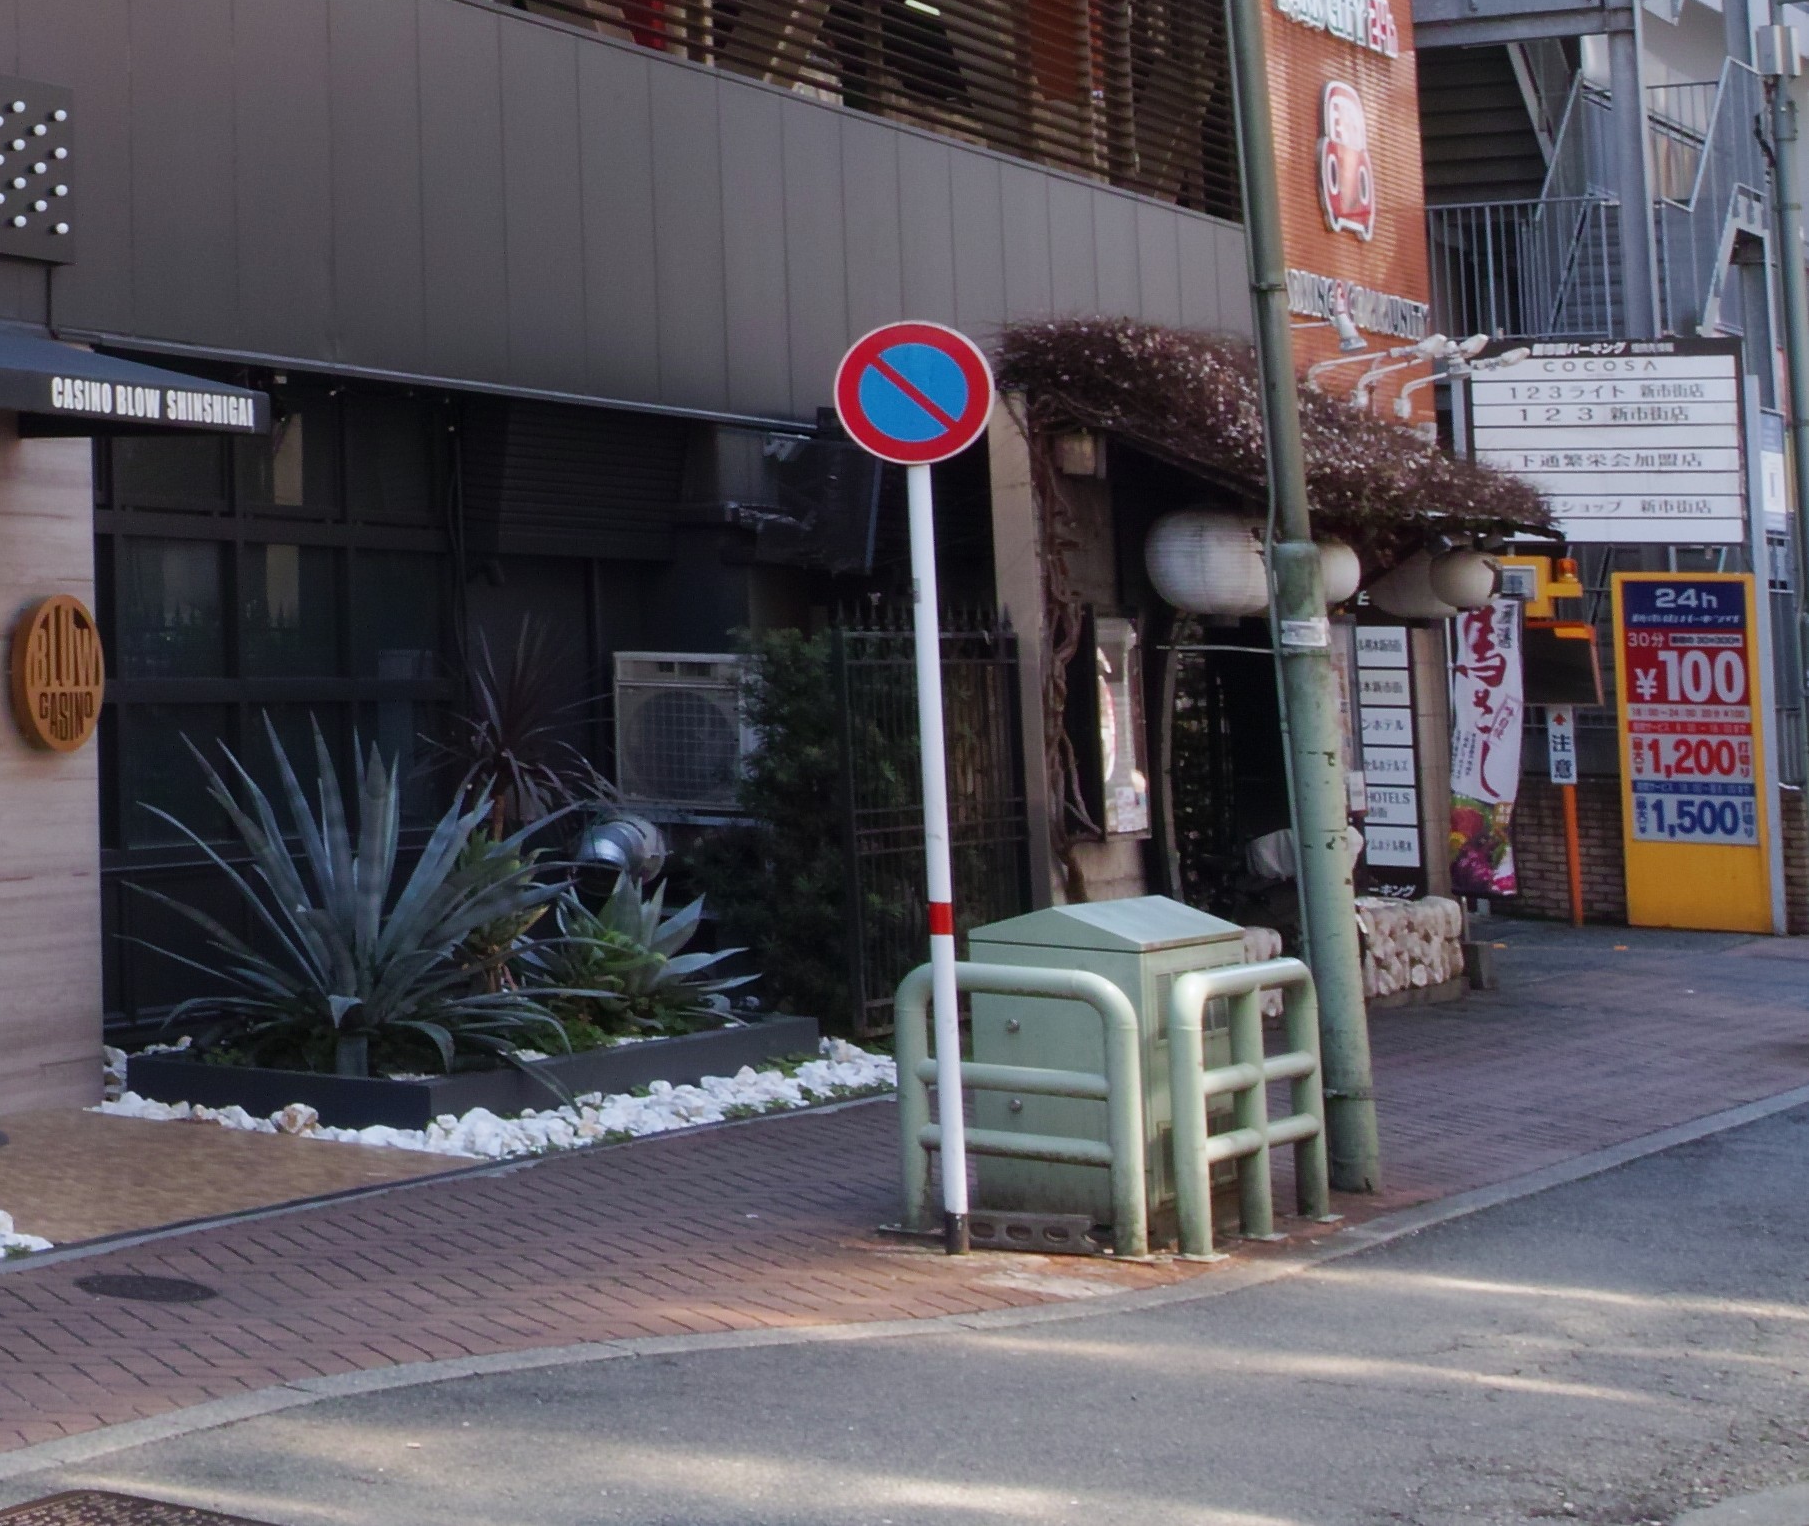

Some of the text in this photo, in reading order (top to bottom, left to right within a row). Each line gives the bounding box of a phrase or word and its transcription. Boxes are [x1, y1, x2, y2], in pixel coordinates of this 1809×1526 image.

[1543, 360, 1657, 373] COCOSA
[51, 377, 254, 426] CASINO BLOW SHINSHIGAI
[1655, 588, 1718, 608] 24h
[1627, 632, 1664, 648] 30分
[1634, 649, 1745, 703] ¥100
[39, 691, 94, 741] CASINO
[1552, 733, 1573, 779] 注意
[1648, 739, 1736, 779] 1,200
[1651, 799, 1740, 838] 1,500
